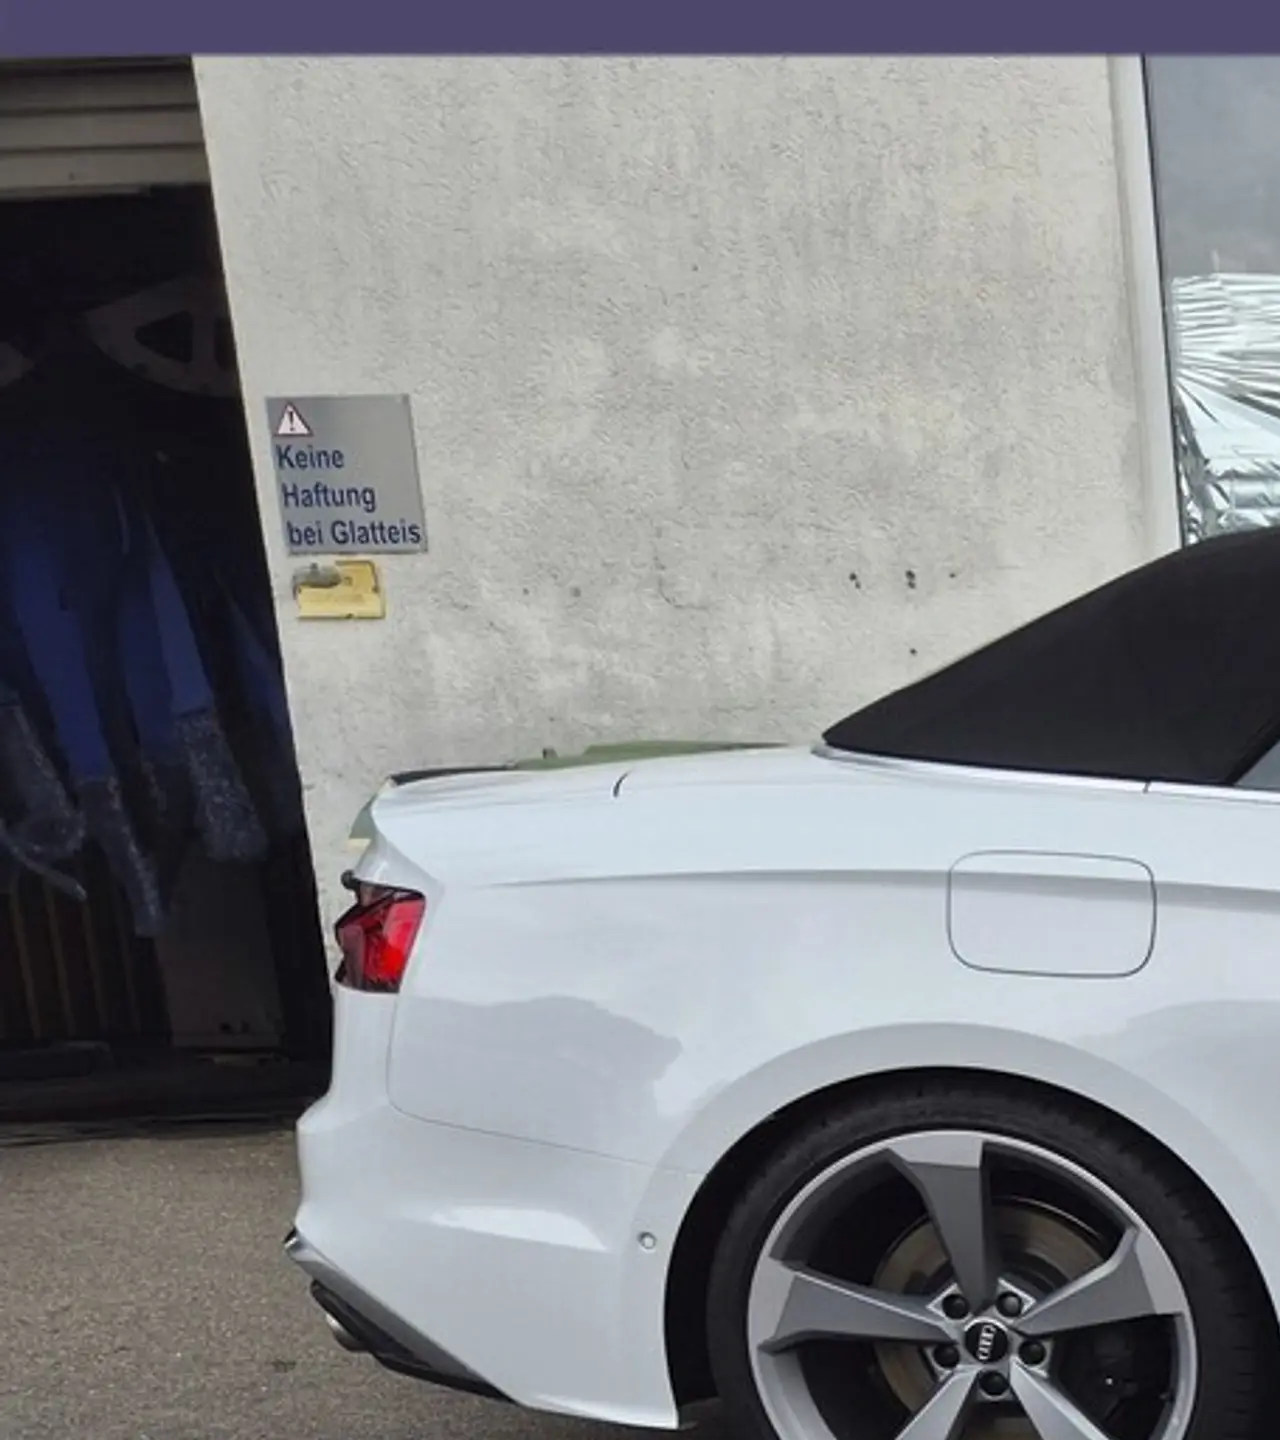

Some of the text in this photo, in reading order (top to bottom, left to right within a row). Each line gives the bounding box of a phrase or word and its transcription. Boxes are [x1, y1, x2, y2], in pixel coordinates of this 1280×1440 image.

[276, 445, 345, 469] Keine
[282, 482, 377, 513] Haftung
[287, 519, 421, 546] bei Glatteis
